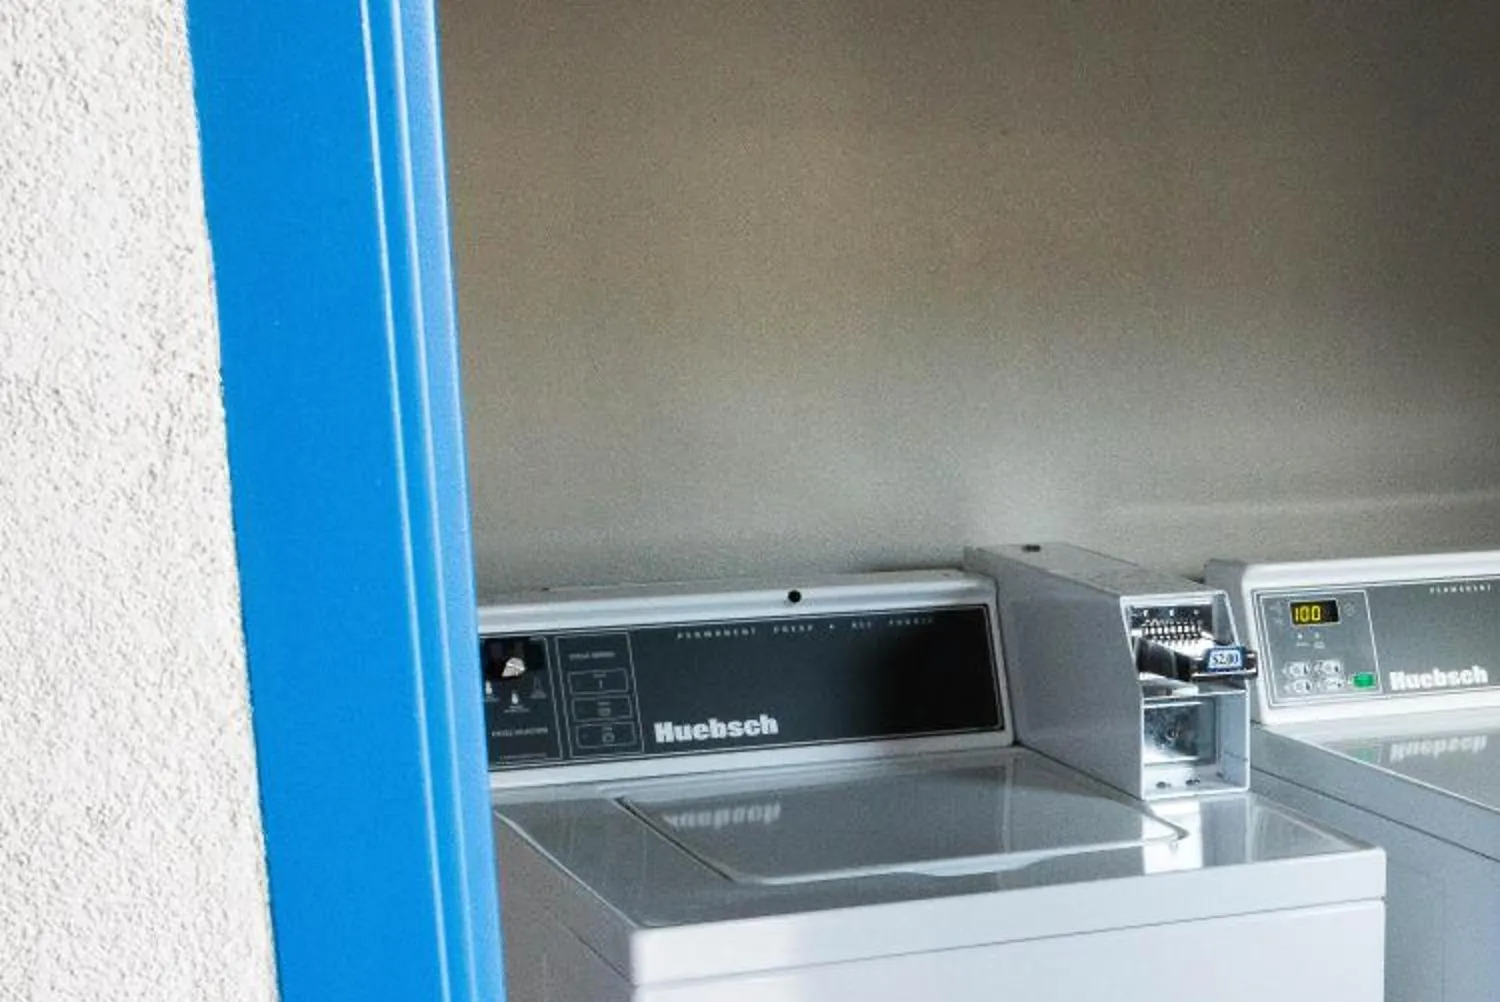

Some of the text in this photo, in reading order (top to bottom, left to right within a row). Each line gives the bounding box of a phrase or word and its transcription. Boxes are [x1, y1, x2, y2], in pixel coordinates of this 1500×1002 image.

[1294, 605, 1322, 622] 100
[1388, 665, 1490, 691] Huebsch
[653, 713, 779, 743] Huebsch
